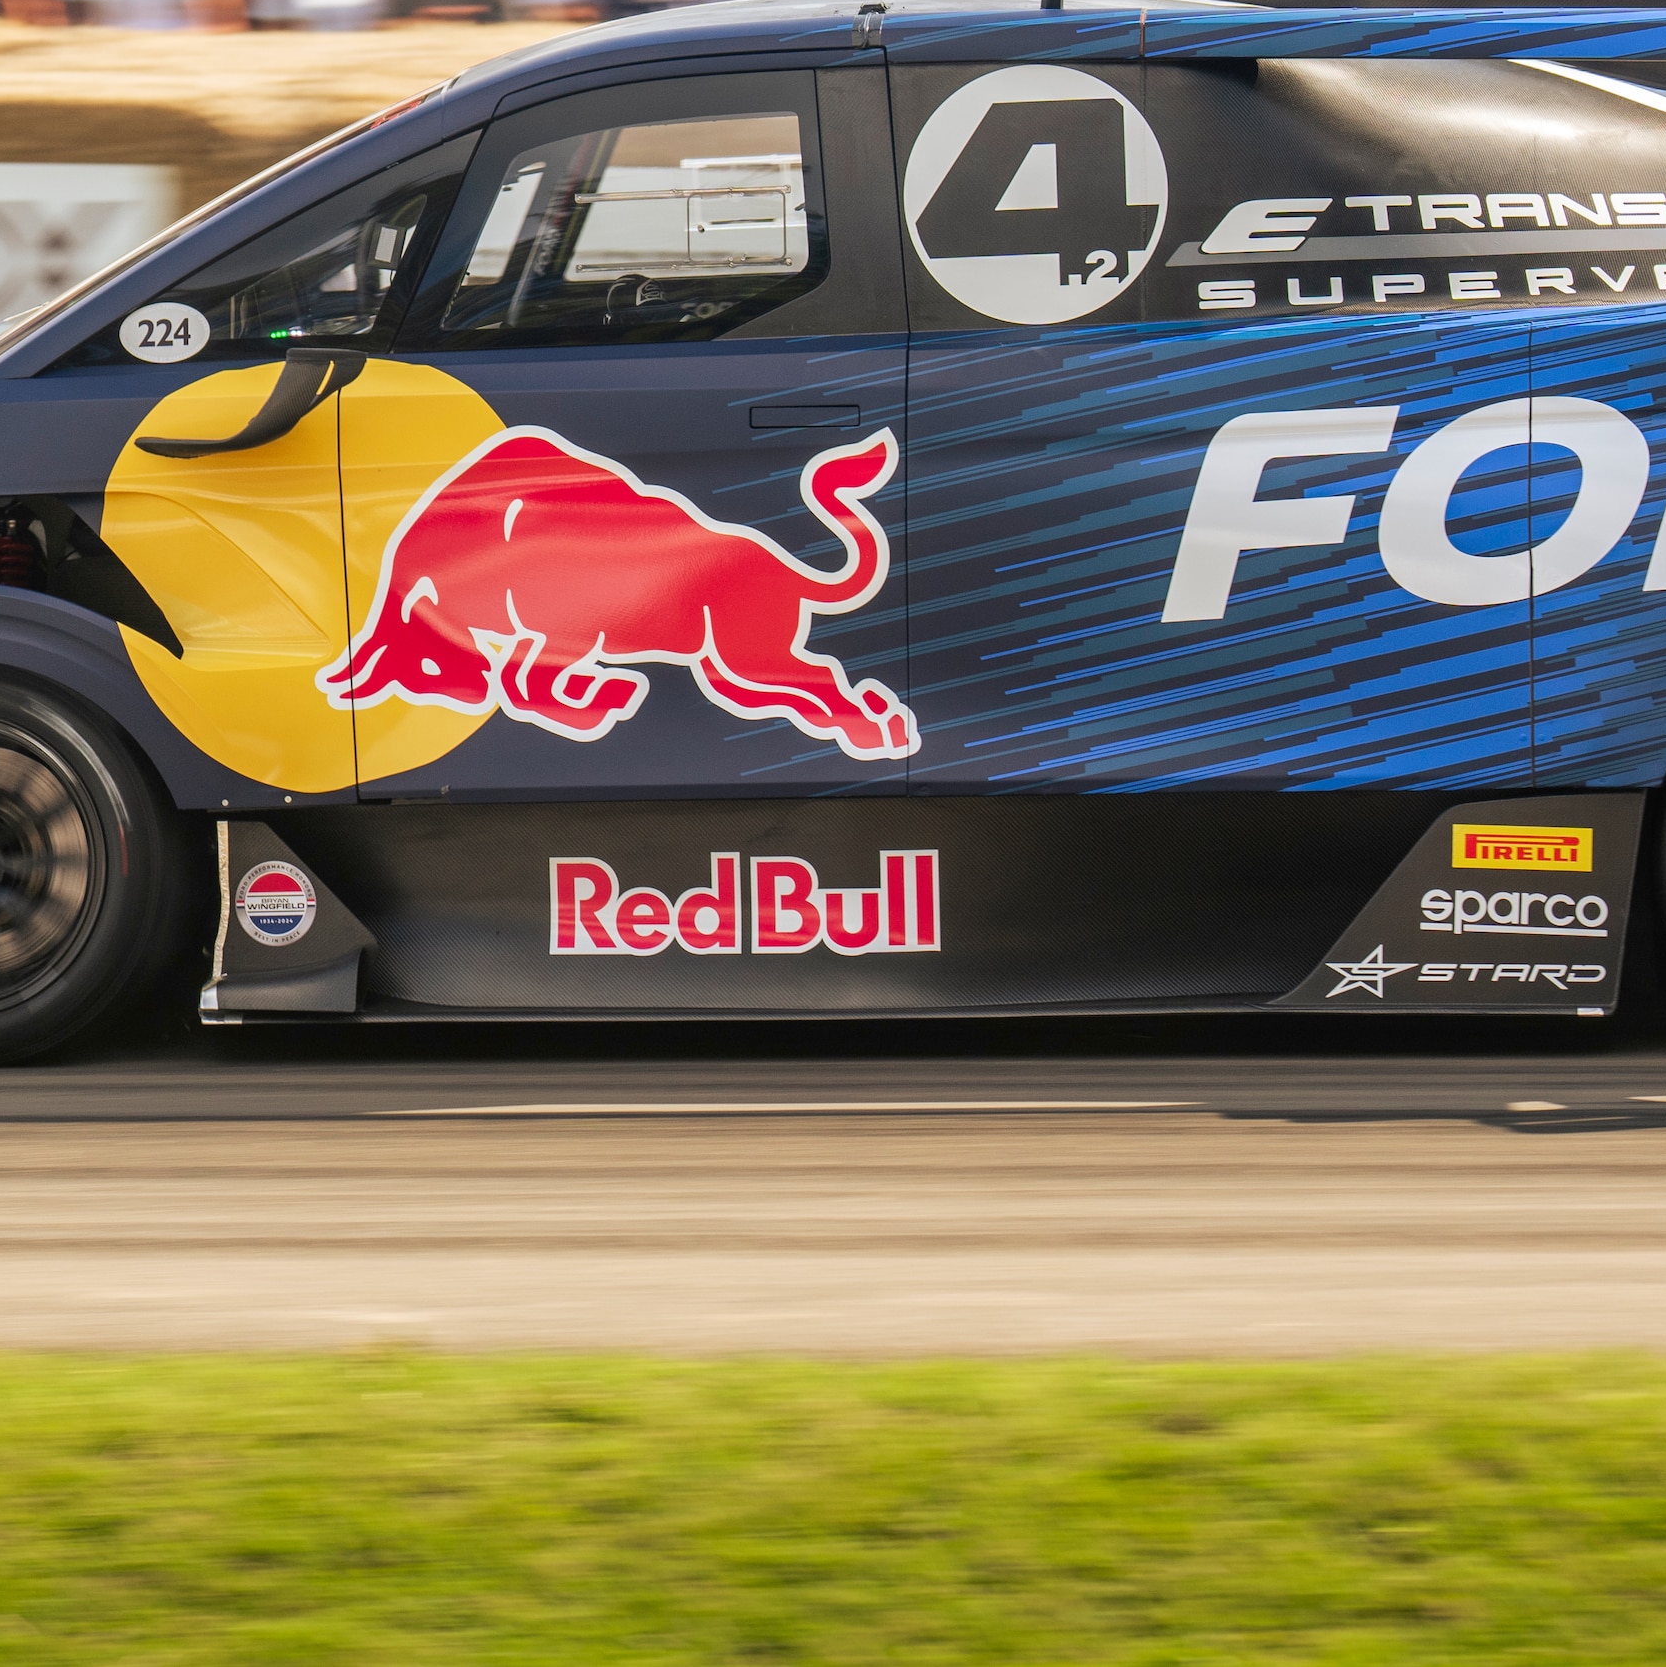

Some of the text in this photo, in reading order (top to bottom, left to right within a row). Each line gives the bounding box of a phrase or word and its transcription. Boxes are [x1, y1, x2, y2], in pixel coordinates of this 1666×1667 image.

[137, 317, 192, 348] 224
[1464, 832, 1581, 863] PIRELLI
[248, 864, 294, 881] PERFORMANCE
[247, 902, 305, 910] WINGFIELD
[1419, 888, 1609, 935] sparco
[254, 931, 269, 942] REST
[281, 930, 301, 942] PEACE
[1416, 962, 1607, 991] STARD
